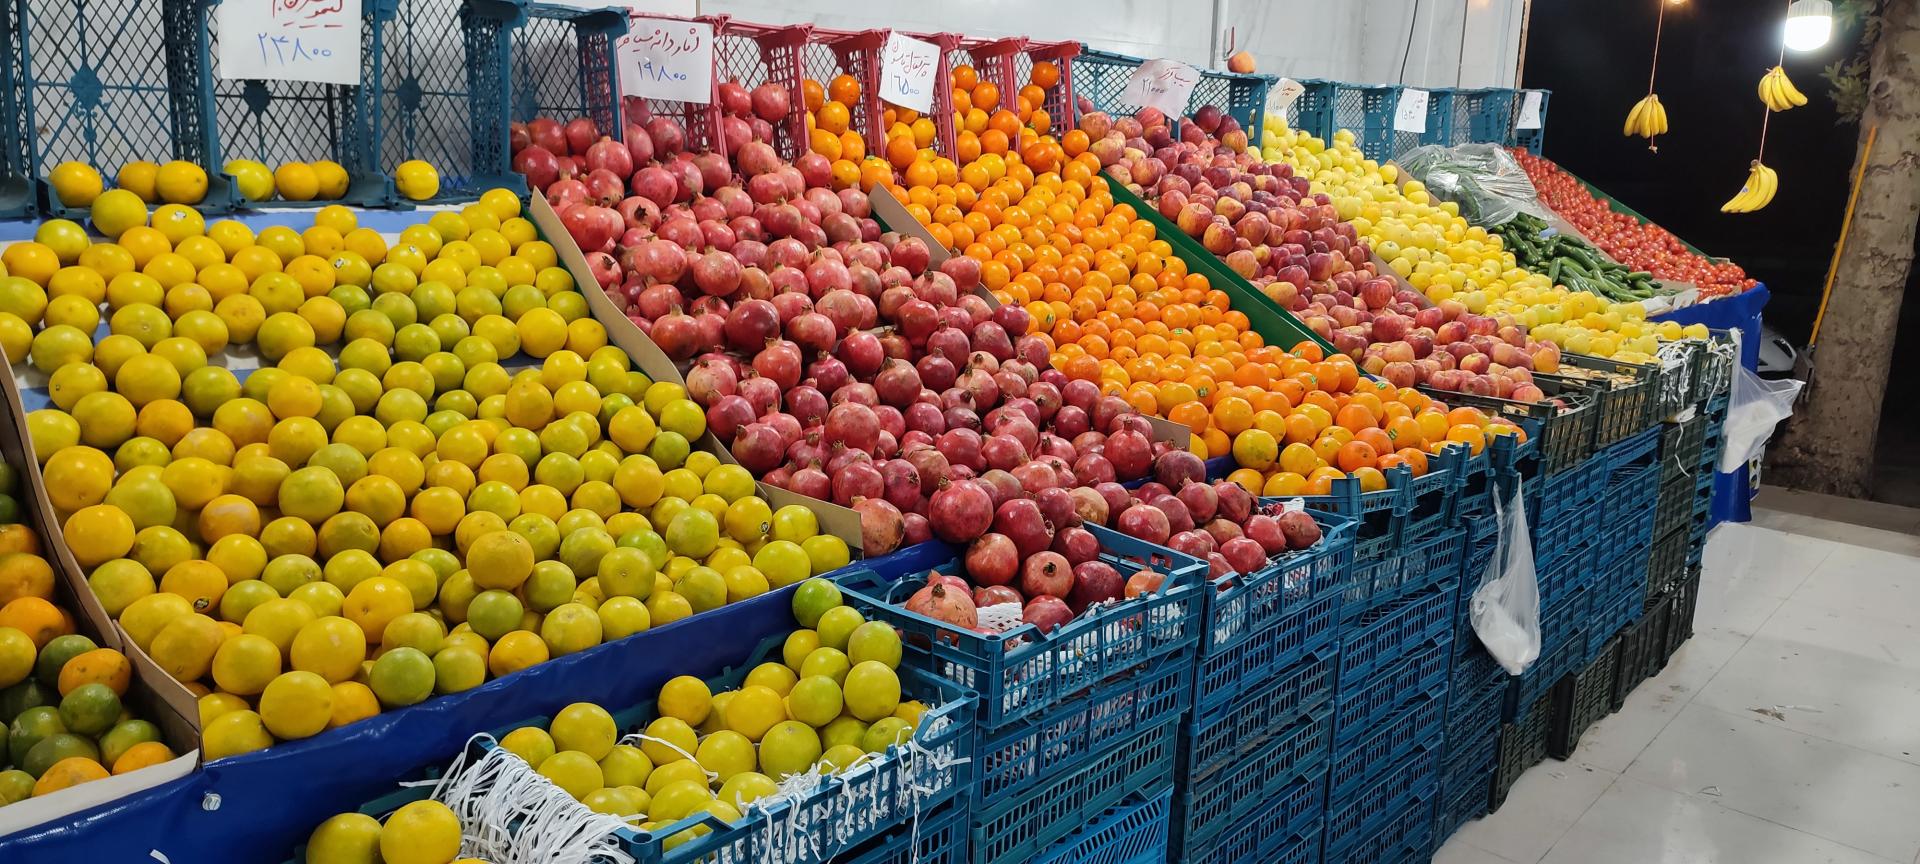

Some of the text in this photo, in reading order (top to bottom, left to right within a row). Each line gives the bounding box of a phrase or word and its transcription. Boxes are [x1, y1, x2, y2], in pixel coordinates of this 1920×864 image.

[257, 32, 332, 67] ۲۴۸۰۰
[671, 27, 700, 57] انار
[637, 60, 688, 82] ۱۹۸۰۰
[890, 71, 920, 96] ۱۶۵۰۰
